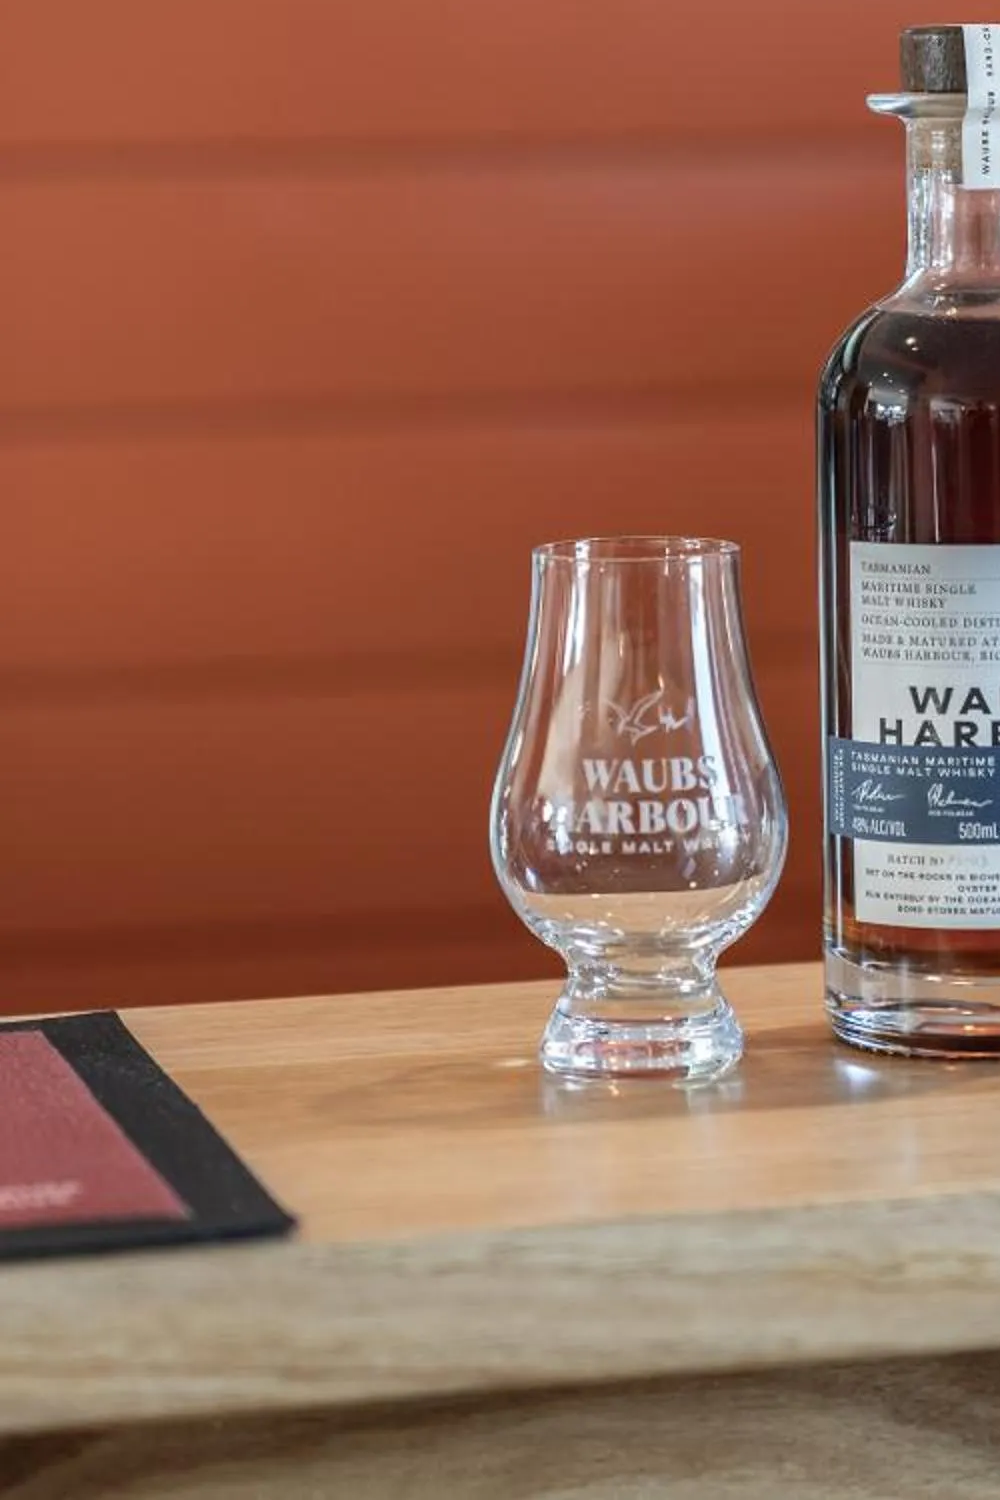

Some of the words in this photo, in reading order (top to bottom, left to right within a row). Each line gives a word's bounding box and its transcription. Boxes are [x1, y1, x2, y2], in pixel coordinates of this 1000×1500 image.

[981, 131, 990, 175] WAUBS
[861, 561, 931, 575] TASMANIAN
[861, 580, 920, 594] MARITIME
[925, 583, 977, 595] SINGLE
[861, 595, 890, 607] MALT
[895, 598, 947, 609] WHISKY
[861, 614, 958, 628] OCEAN-COOLED
[862, 633, 892, 645] MADE
[909, 635, 977, 647] MATURED
[981, 636, 999, 647] AT
[863, 647, 901, 659] WAUBS
[851, 750, 919, 765] TASMANIAN
[925, 756, 995, 767] MARITIME
[583, 755, 718, 792] WAUBS
[851, 761, 891, 775] SINGLE
[896, 767, 932, 777] MALT
[938, 768, 995, 778] WHISKY
[545, 838, 611, 855] SGLE
[622, 840, 674, 855] MALT
[887, 854, 925, 866] BATCH
[944, 895, 962, 904] THE
